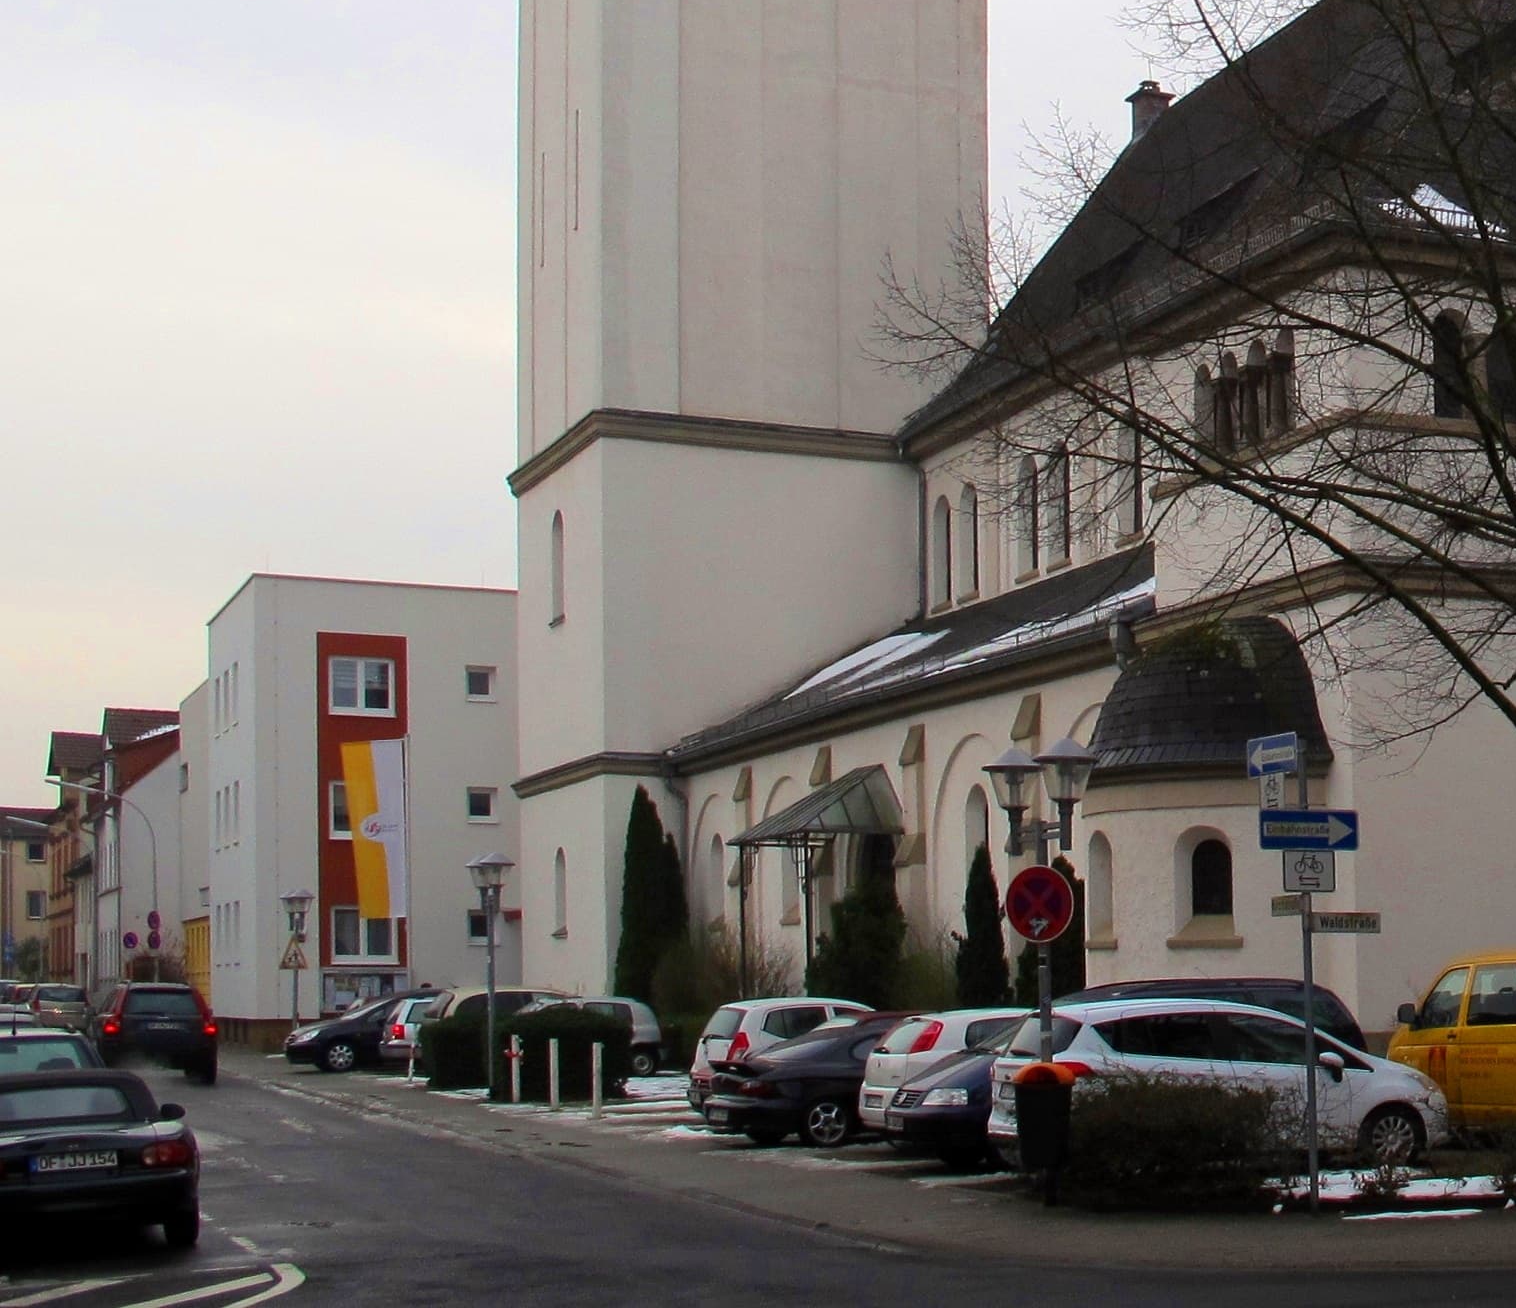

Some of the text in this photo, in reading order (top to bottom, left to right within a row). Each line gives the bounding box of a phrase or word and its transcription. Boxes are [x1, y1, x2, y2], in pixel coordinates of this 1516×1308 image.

[1266, 823, 1329, 835] Einbahnstraße
[1320, 915, 1377, 929] Waldstraße
[39, 1155, 57, 1170] OF
[88, 1151, 116, 1166] 154
